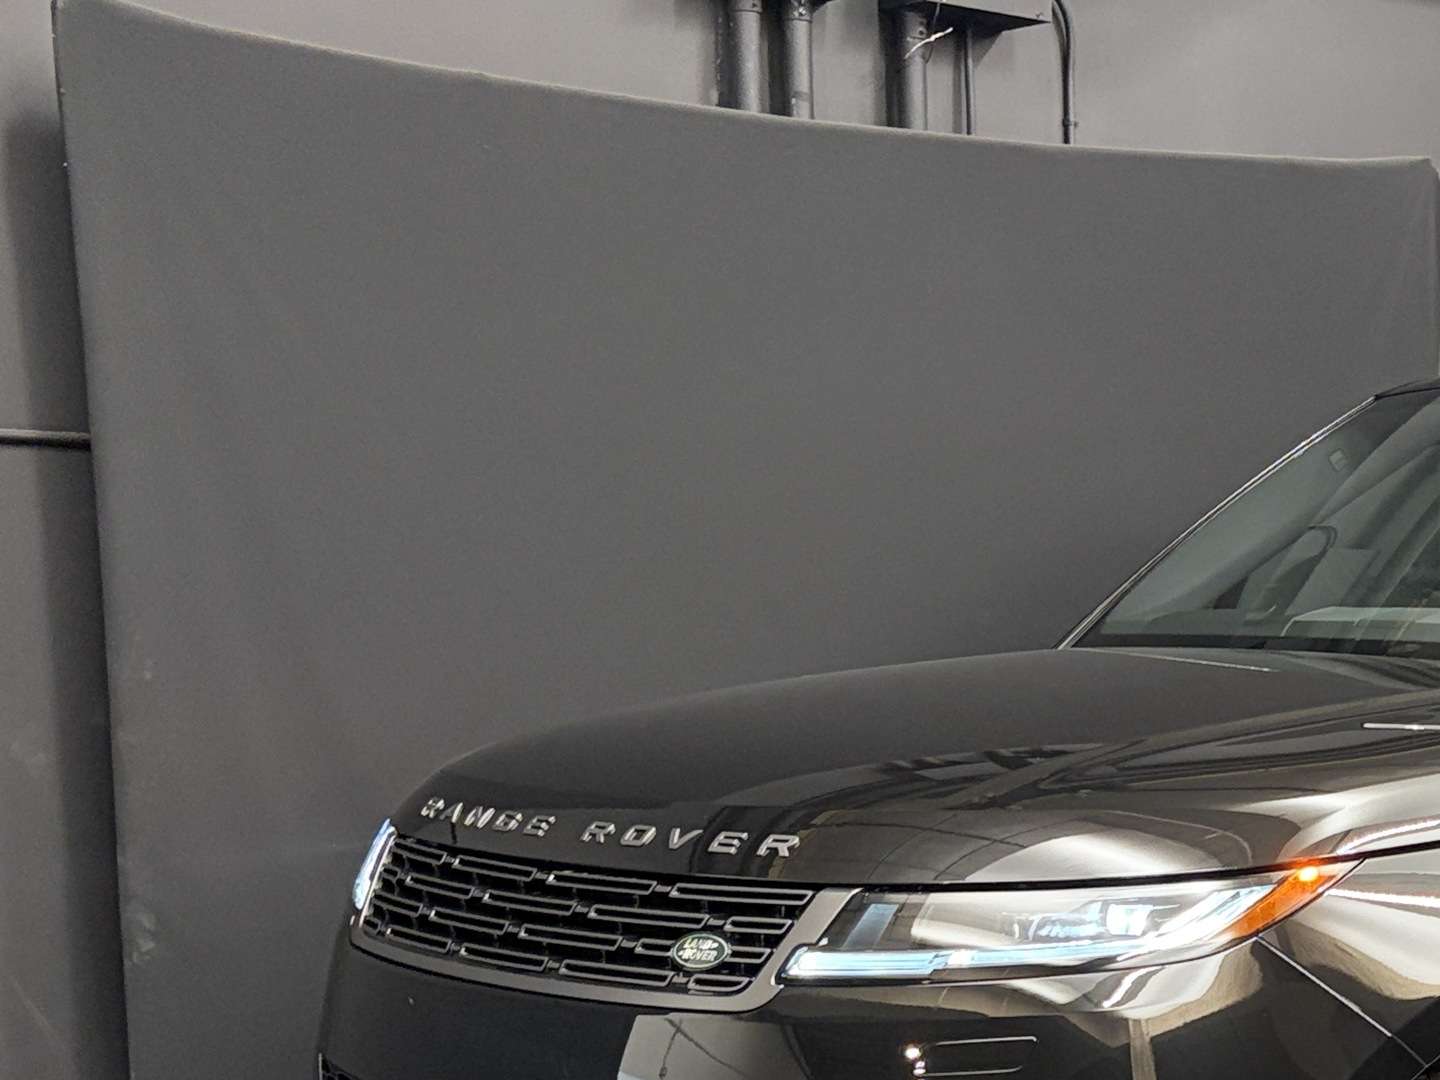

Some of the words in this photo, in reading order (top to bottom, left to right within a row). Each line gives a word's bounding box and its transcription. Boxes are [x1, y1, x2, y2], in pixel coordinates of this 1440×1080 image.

[421, 797, 556, 837] RANGE
[580, 820, 800, 857] ROVER
[682, 938, 714, 949] LAND
[682, 949, 718, 961] ROVER
